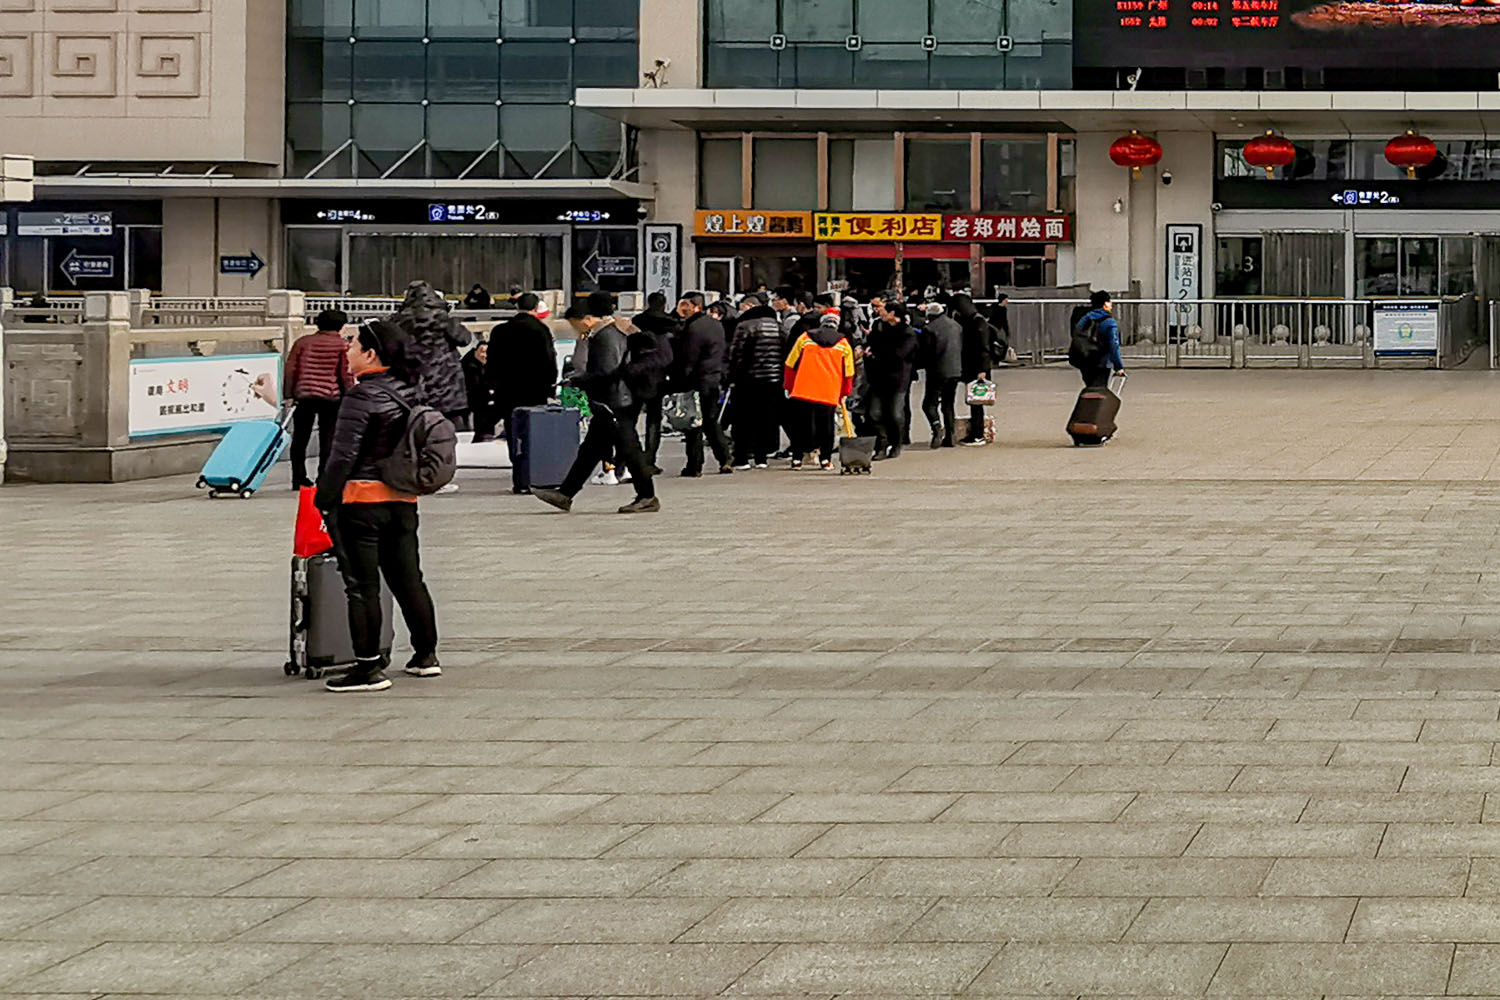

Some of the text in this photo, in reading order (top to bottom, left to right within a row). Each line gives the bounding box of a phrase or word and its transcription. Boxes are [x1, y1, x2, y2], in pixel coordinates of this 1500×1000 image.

[705, 214, 765, 233] 煌上煌
[846, 216, 938, 237] 便利店
[949, 216, 1065, 239] 老郑州烩面
[1243, 255, 1254, 272] 3
